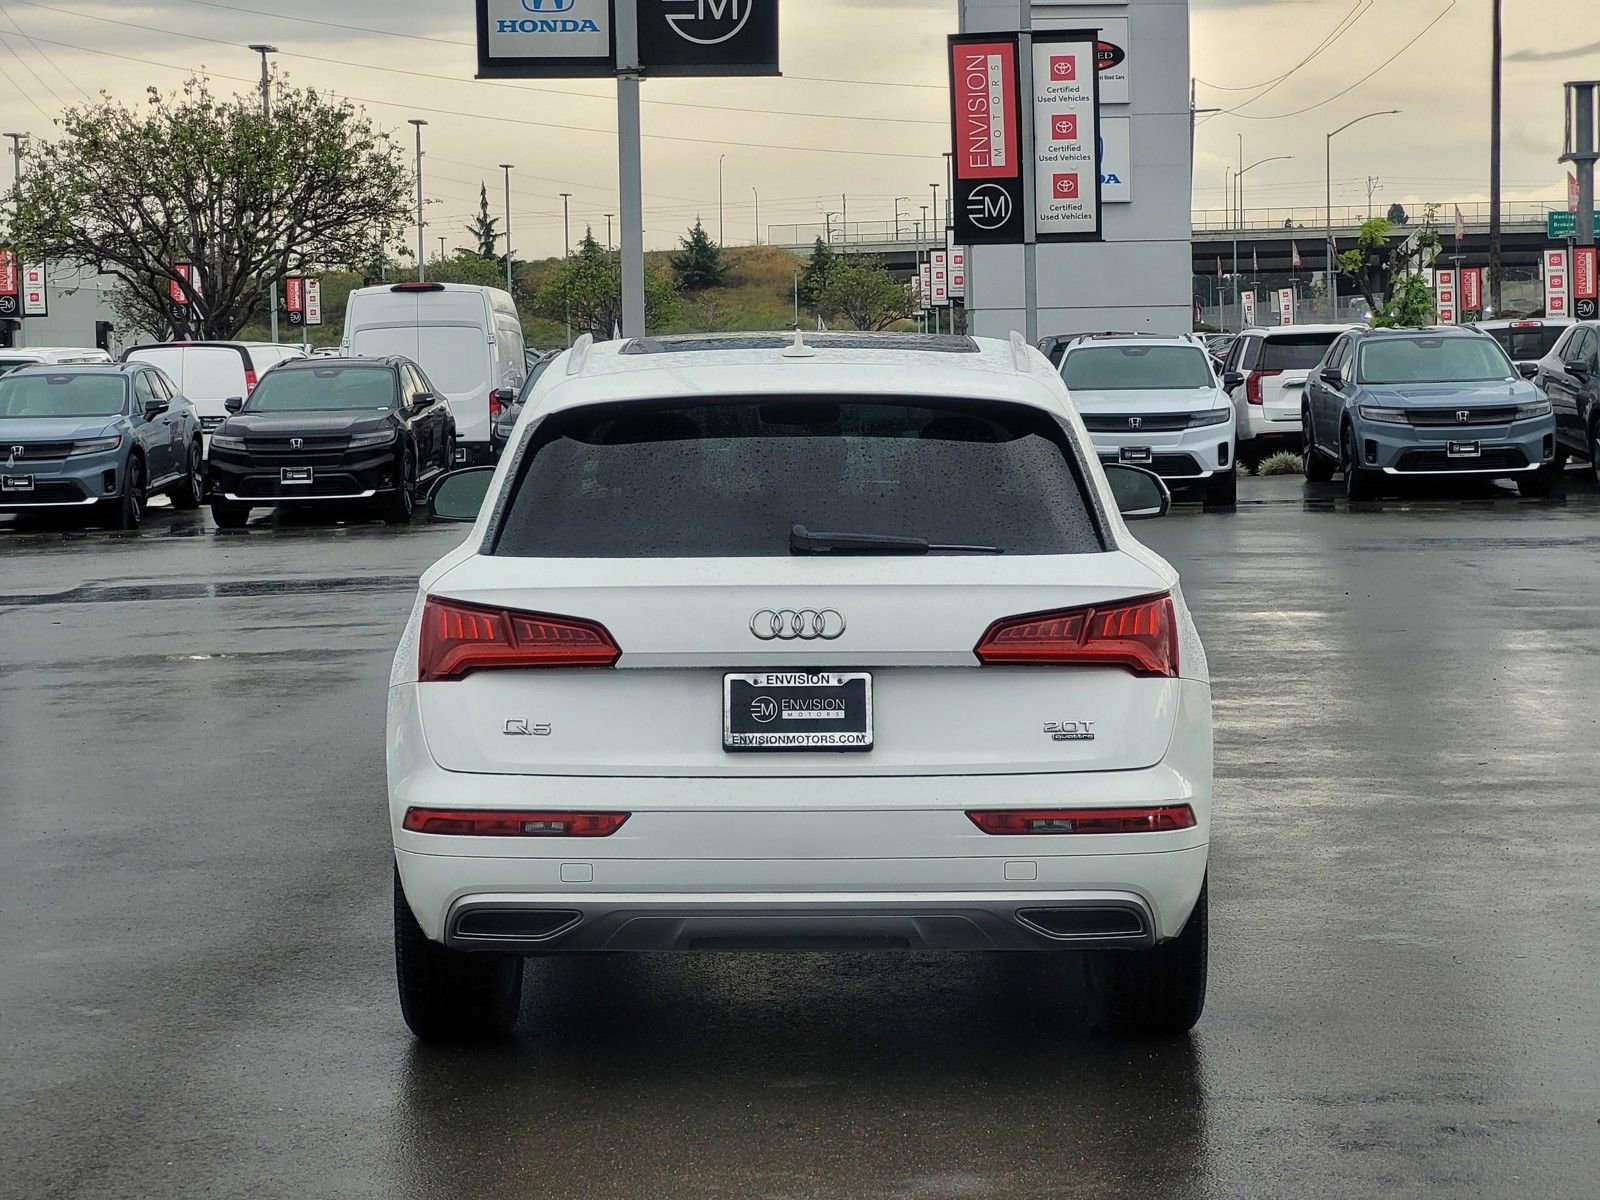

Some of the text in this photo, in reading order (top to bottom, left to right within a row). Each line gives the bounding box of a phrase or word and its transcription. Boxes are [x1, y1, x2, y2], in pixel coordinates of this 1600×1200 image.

[496, 19, 601, 33] HONDA
[1097, 51, 1113, 60] ED
[1046, 86, 1080, 94] Certified
[966, 55, 990, 168] ENVISION
[991, 64, 1002, 157] MOTORS
[1049, 204, 1083, 212] Certified
[1578, 252, 1586, 294] ENVISION
[766, 675, 830, 685] ENVISION
[781, 699, 845, 710] ENVISION
[503, 718, 552, 736] Q5
[732, 735, 866, 744] ENVISIONMOTORS.COM
